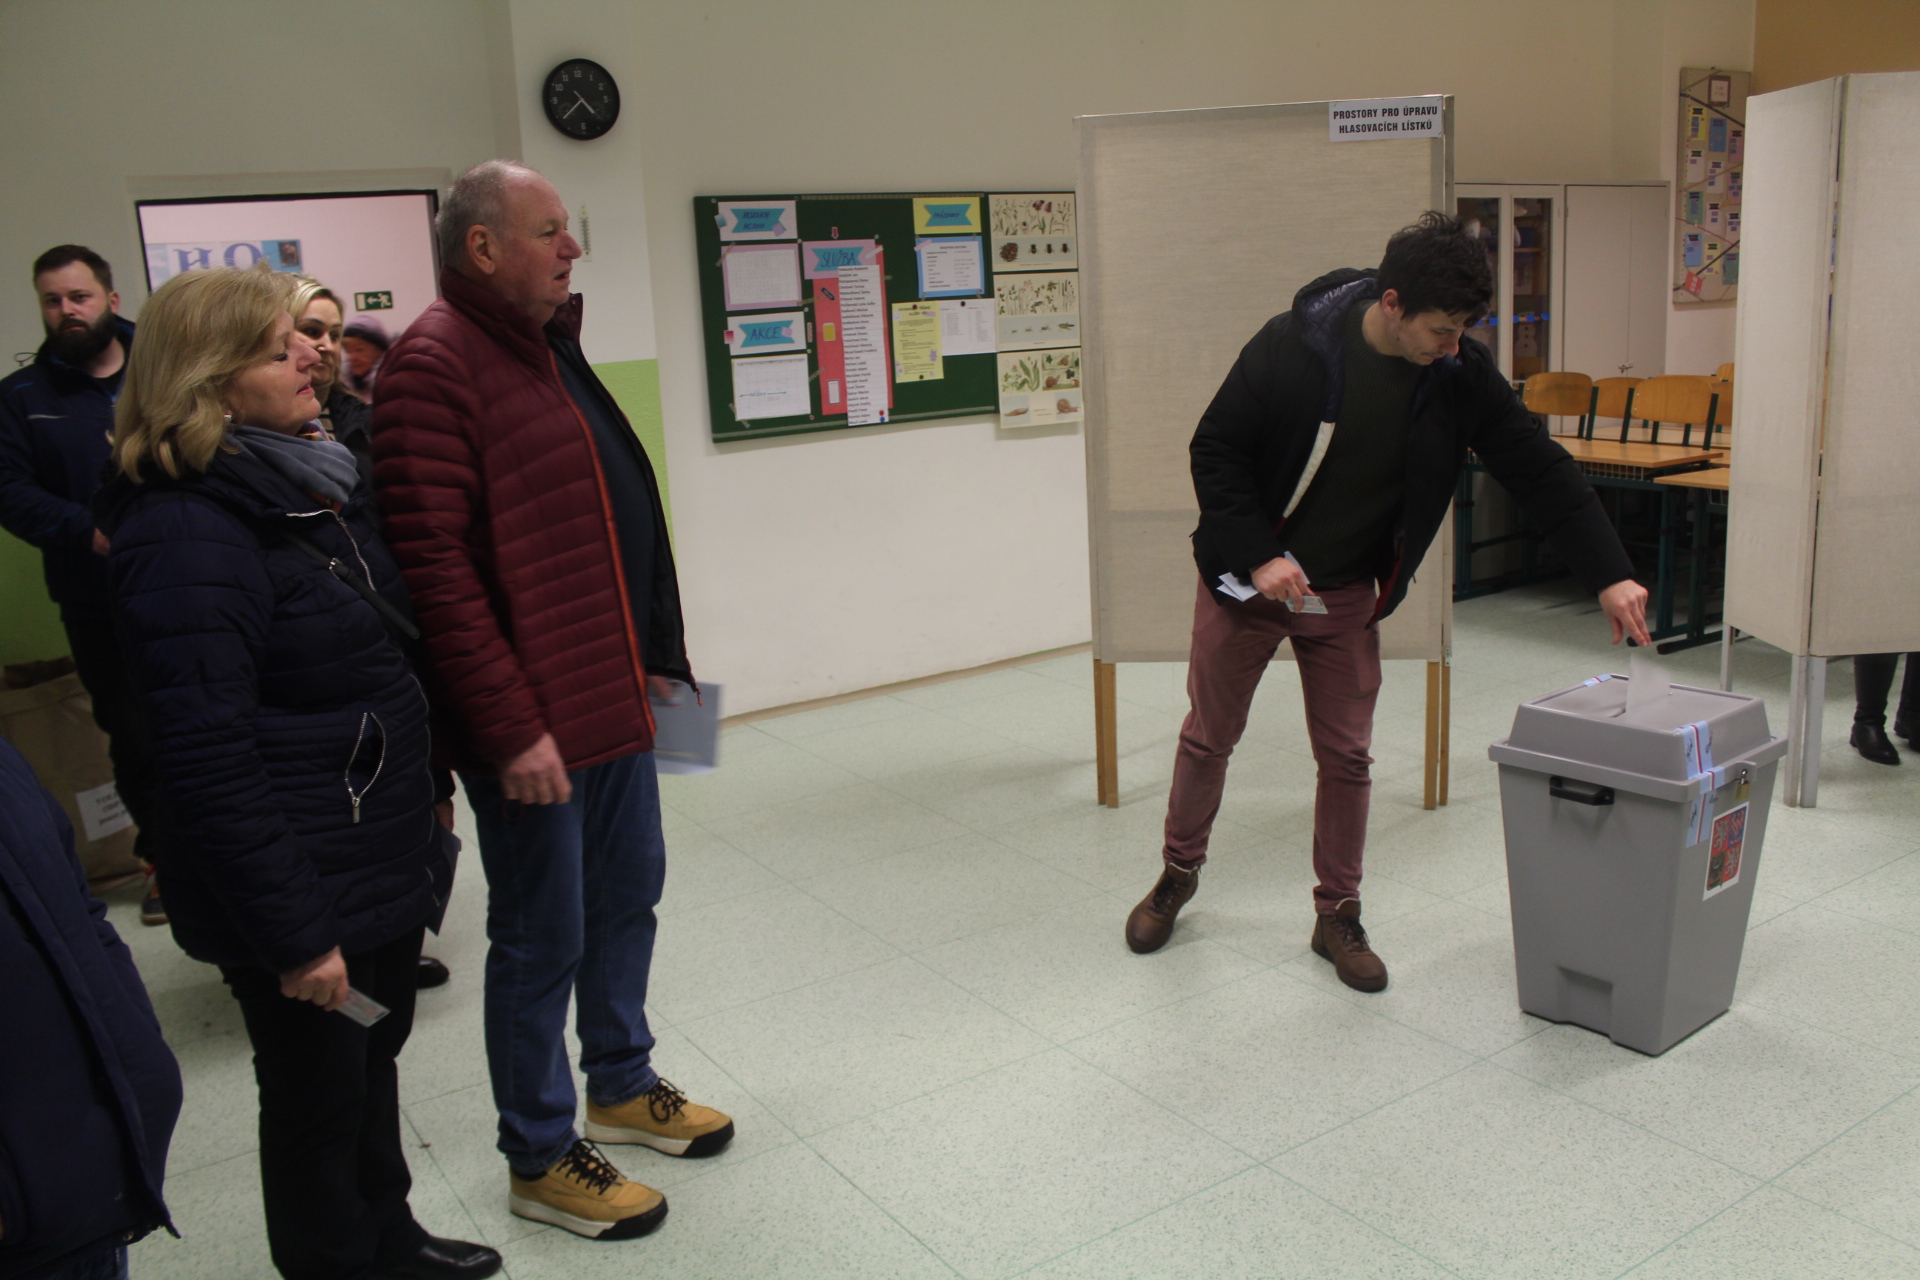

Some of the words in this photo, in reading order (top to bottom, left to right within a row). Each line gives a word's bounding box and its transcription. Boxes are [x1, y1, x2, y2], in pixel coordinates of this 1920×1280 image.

[562, 74, 569, 82] 11
[574, 70, 582, 78] 12
[555, 83, 564, 91] 10
[598, 83, 604, 91] 2
[552, 96, 558, 104] 9
[603, 95, 608, 103] 3
[1333, 108, 1379, 120] PROSTORY
[1382, 107, 1399, 117] PRO
[1403, 105, 1438, 116] ÚPRAVU
[580, 122, 587, 130] 6
[1339, 120, 1398, 134] HLASOVACÍCH
[820, 249, 856, 267] SLUŽBA
[750, 325, 781, 341] AKCE
